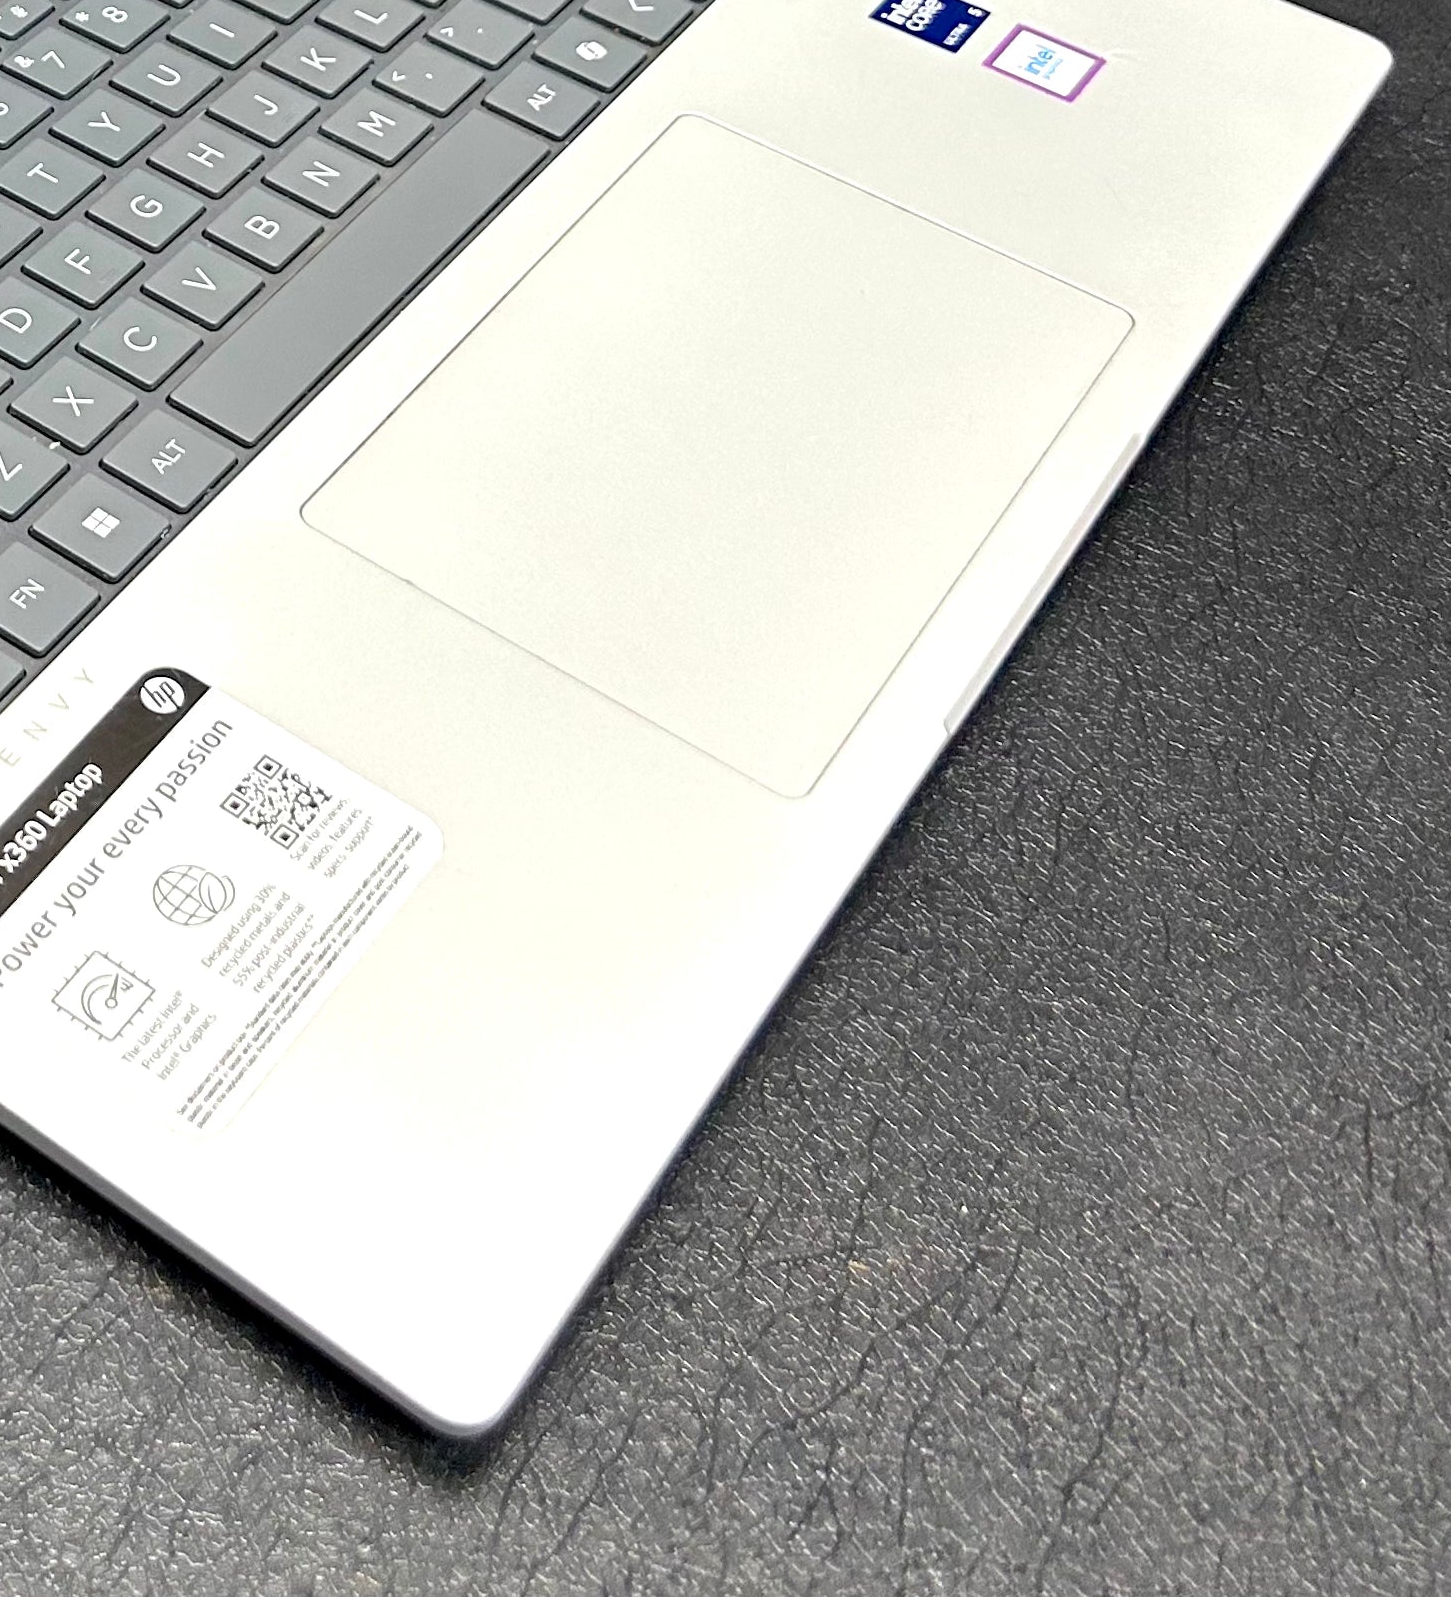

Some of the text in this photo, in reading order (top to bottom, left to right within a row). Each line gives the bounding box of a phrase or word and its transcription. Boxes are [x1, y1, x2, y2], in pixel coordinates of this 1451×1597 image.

[101, 6, 129, 23] 8
[353, 9, 388, 25] L
[209, 23, 235, 38] I
[41, 50, 65, 69] 7
[300, 47, 337, 72] K
[1017, 43, 1059, 76] intel
[147, 64, 181, 86] U
[253, 94, 279, 116] J
[526, 84, 556, 112] ALT
[87, 111, 121, 132] Y
[357, 110, 396, 138] M
[187, 142, 225, 168] H
[26, 162, 59, 184] T
[302, 160, 341, 187] N
[130, 194, 163, 218] G
[244, 215, 280, 240] B
[64, 248, 92, 275] F
[181, 266, 217, 291] V
[123, 326, 158, 352] C
[52, 385, 95, 417] X
[151, 438, 186, 475] ALT
[9, 578, 45, 610] FN
[146, 679, 179, 711] hp
[36, 761, 104, 828] Laptop
[53, 857, 106, 917] your
[101, 796, 164, 859] every
[154, 718, 234, 803] passion
[200, 925, 241, 969] Designed
[237, 903, 263, 929] using
[218, 889, 292, 978] recycled metals and
[232, 965, 256, 988] 55%
[252, 955, 284, 995] recycled
[120, 1019, 163, 1064] The latest
[141, 1002, 201, 1071] Processor and
[178, 1013, 218, 1054] Graphics
